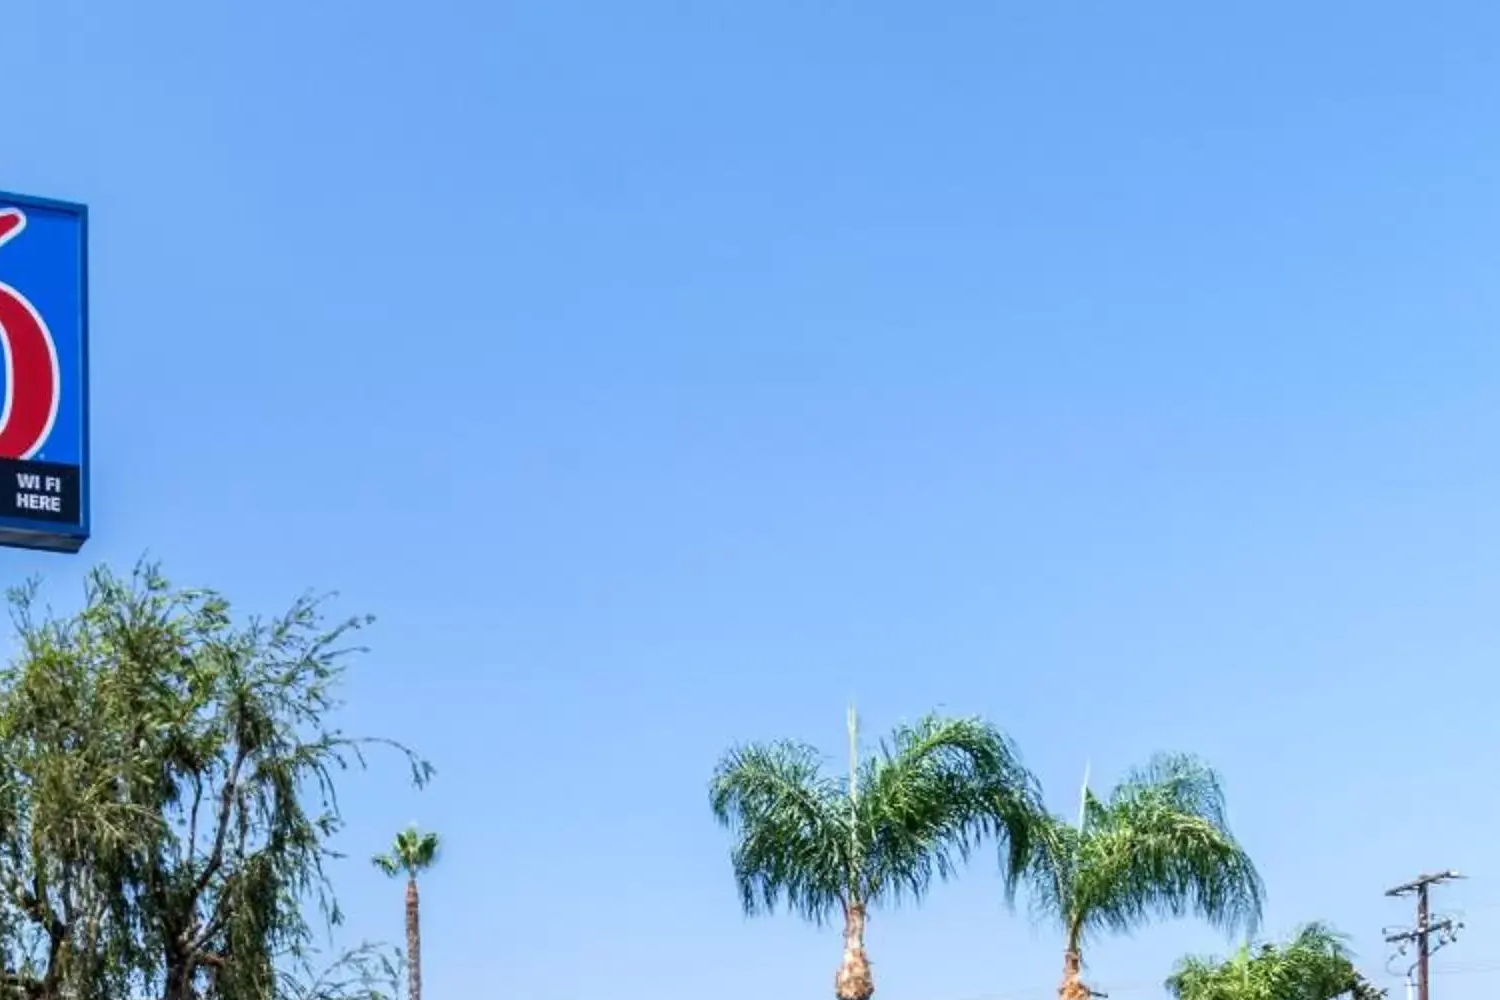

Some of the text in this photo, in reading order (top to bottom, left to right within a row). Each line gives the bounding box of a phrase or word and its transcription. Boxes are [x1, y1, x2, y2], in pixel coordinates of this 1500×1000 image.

[16, 472, 61, 493] WI FI
[16, 492, 61, 512] HERE
